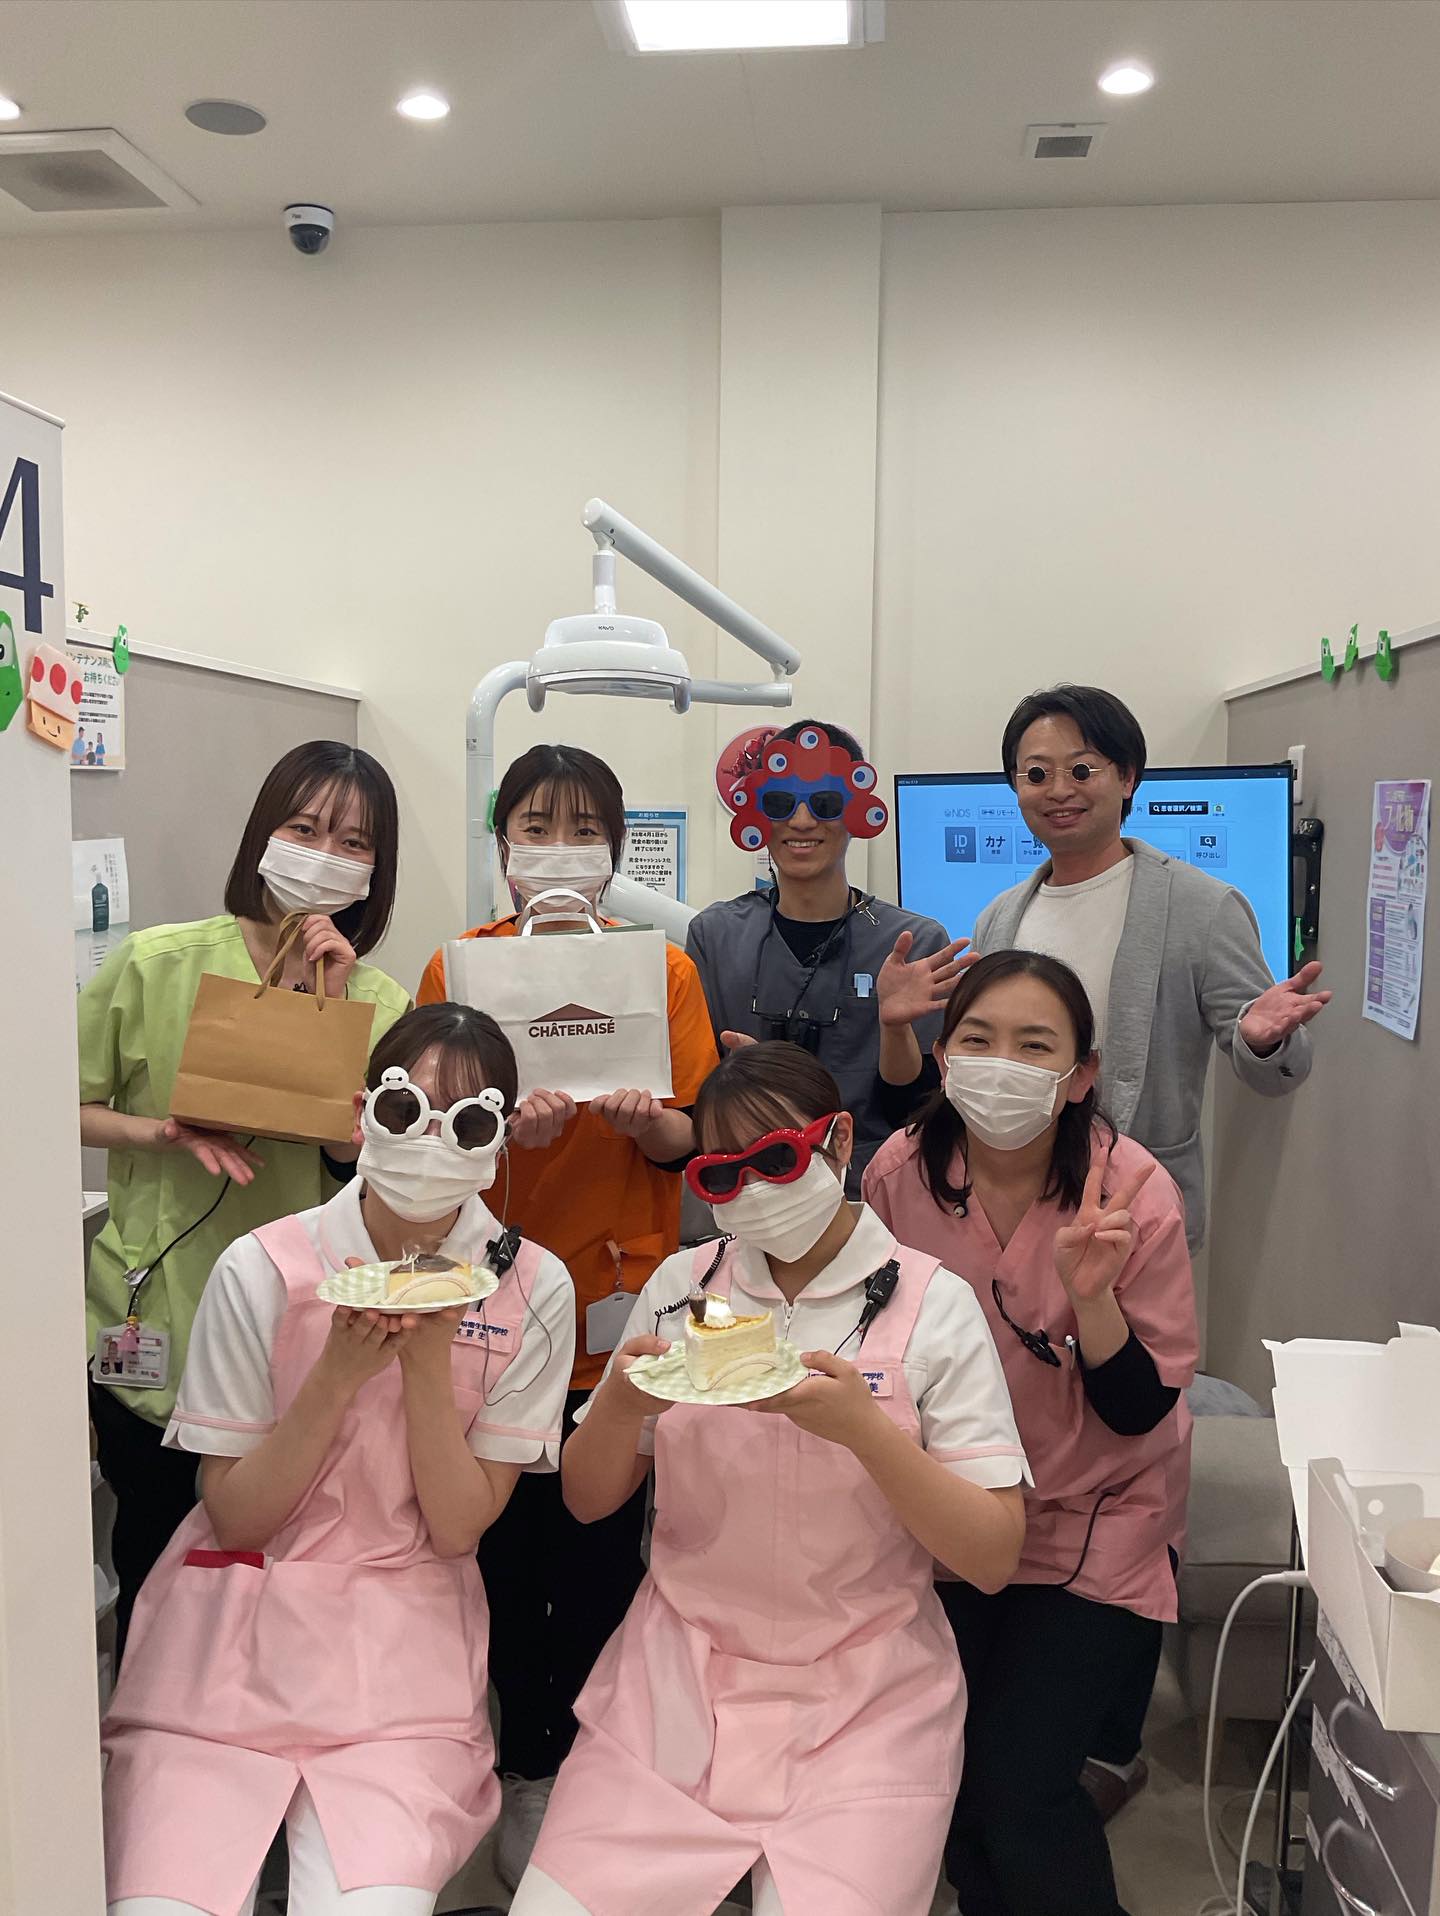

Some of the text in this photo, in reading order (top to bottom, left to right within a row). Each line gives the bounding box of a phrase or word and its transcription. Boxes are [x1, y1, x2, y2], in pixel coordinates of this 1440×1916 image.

[0, 457, 54, 634] 4
[954, 834, 968, 848] ID
[985, 835, 1006, 848] カナ
[528, 1019, 615, 1038] CHÂTERAISÉ
